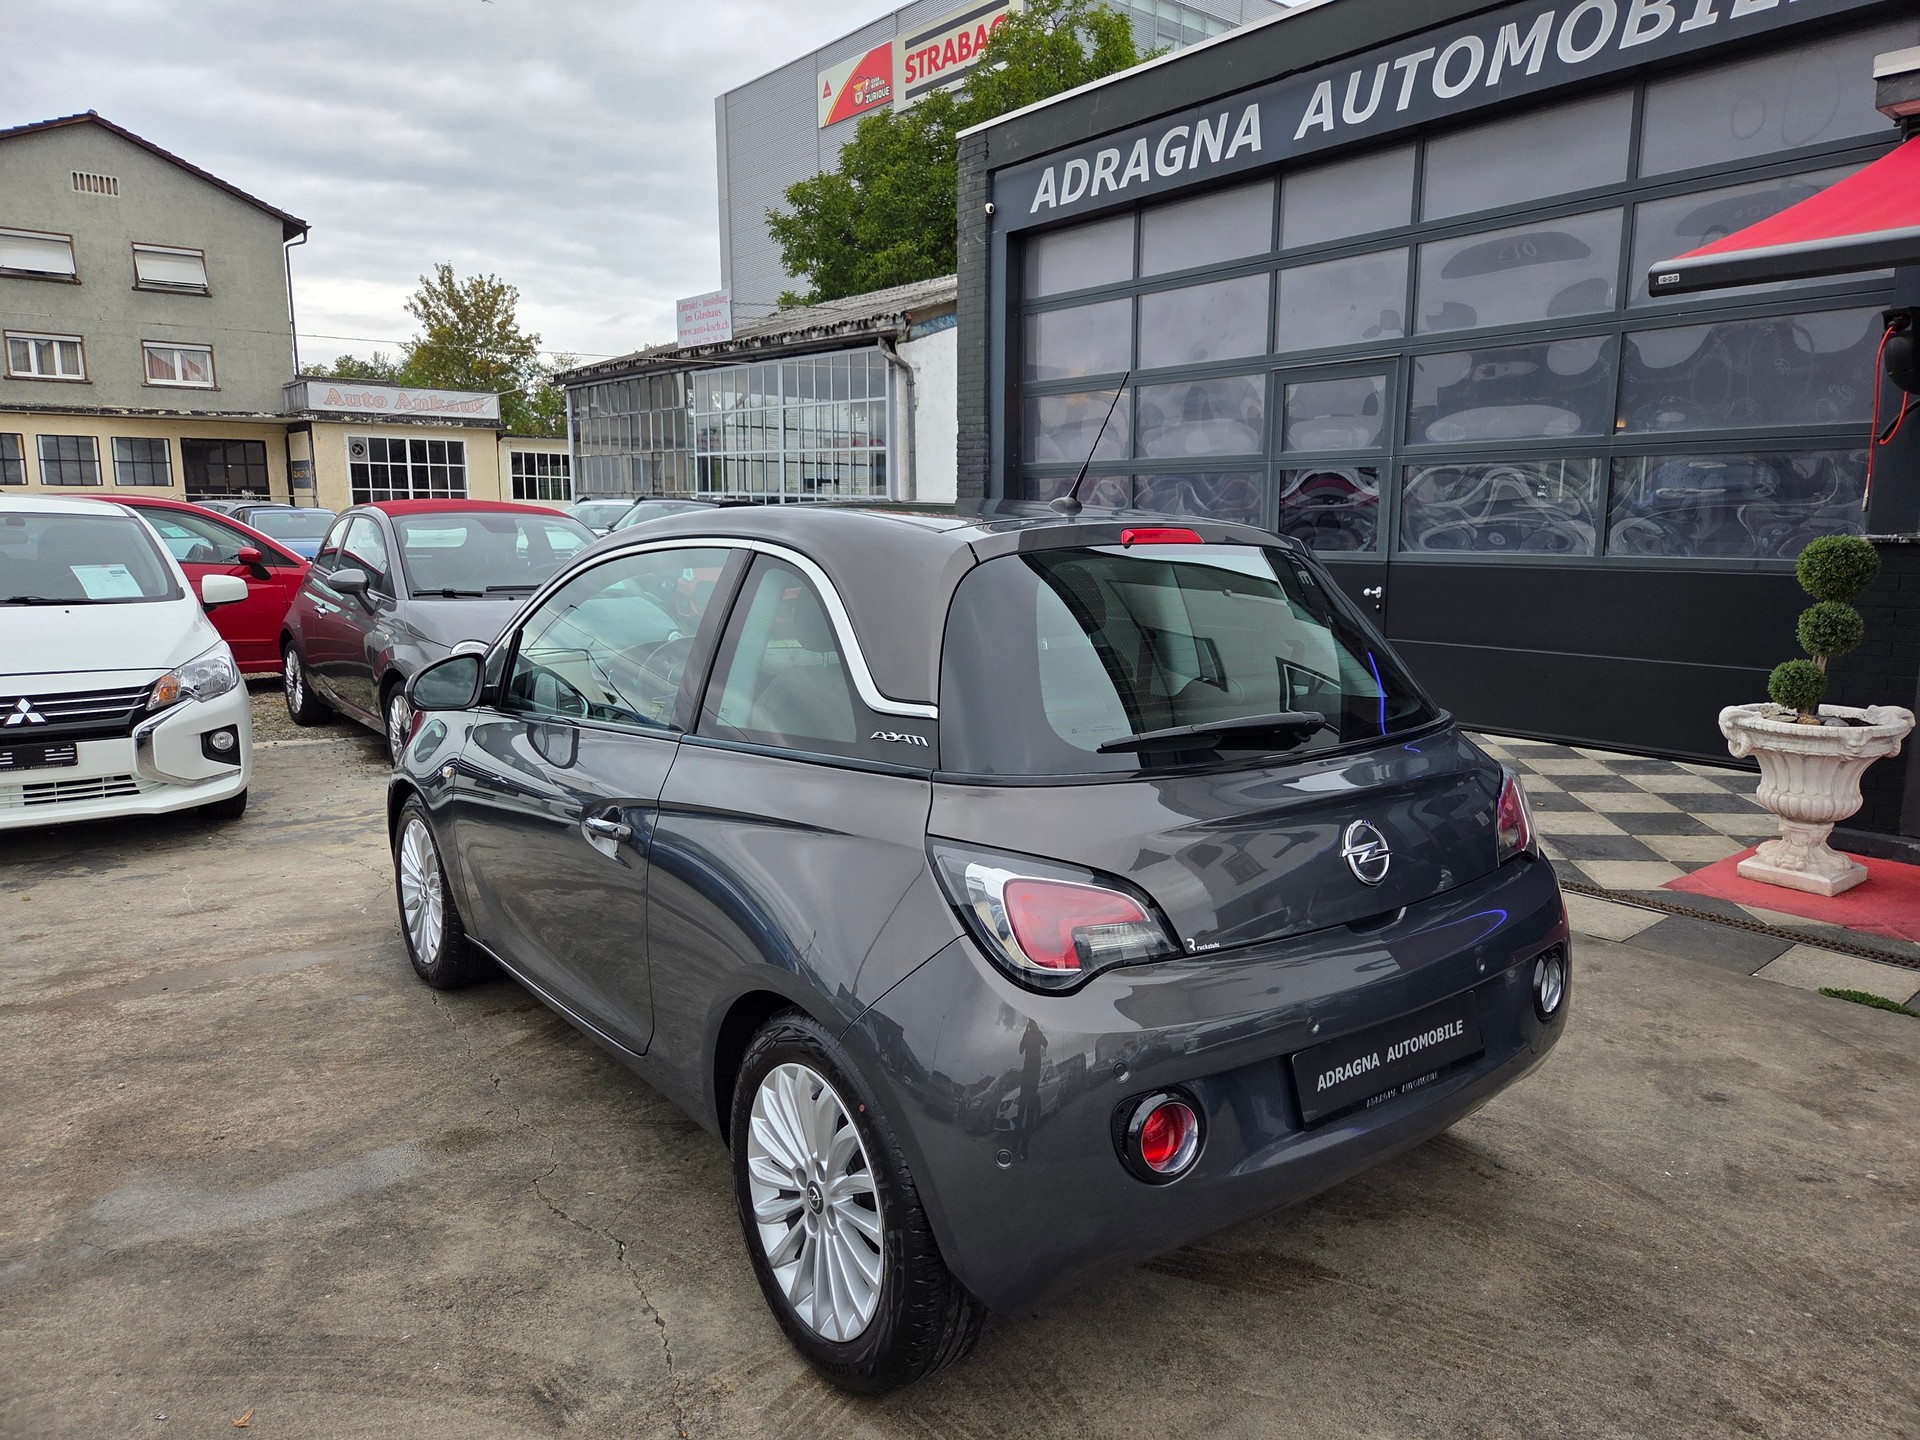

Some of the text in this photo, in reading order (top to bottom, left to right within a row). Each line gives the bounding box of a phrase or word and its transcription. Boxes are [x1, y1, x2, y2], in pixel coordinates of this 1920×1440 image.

[865, 86, 890, 104] ZURIQUE
[1030, 103, 1262, 213] ADRAGNA
[685, 308, 721, 323] im Glashaus
[679, 320, 729, 335] www.auto-koch.ch
[324, 387, 485, 414] Auto Ankauf
[1316, 1019, 1464, 1092] ADRAGNA AUTOMOBILE
